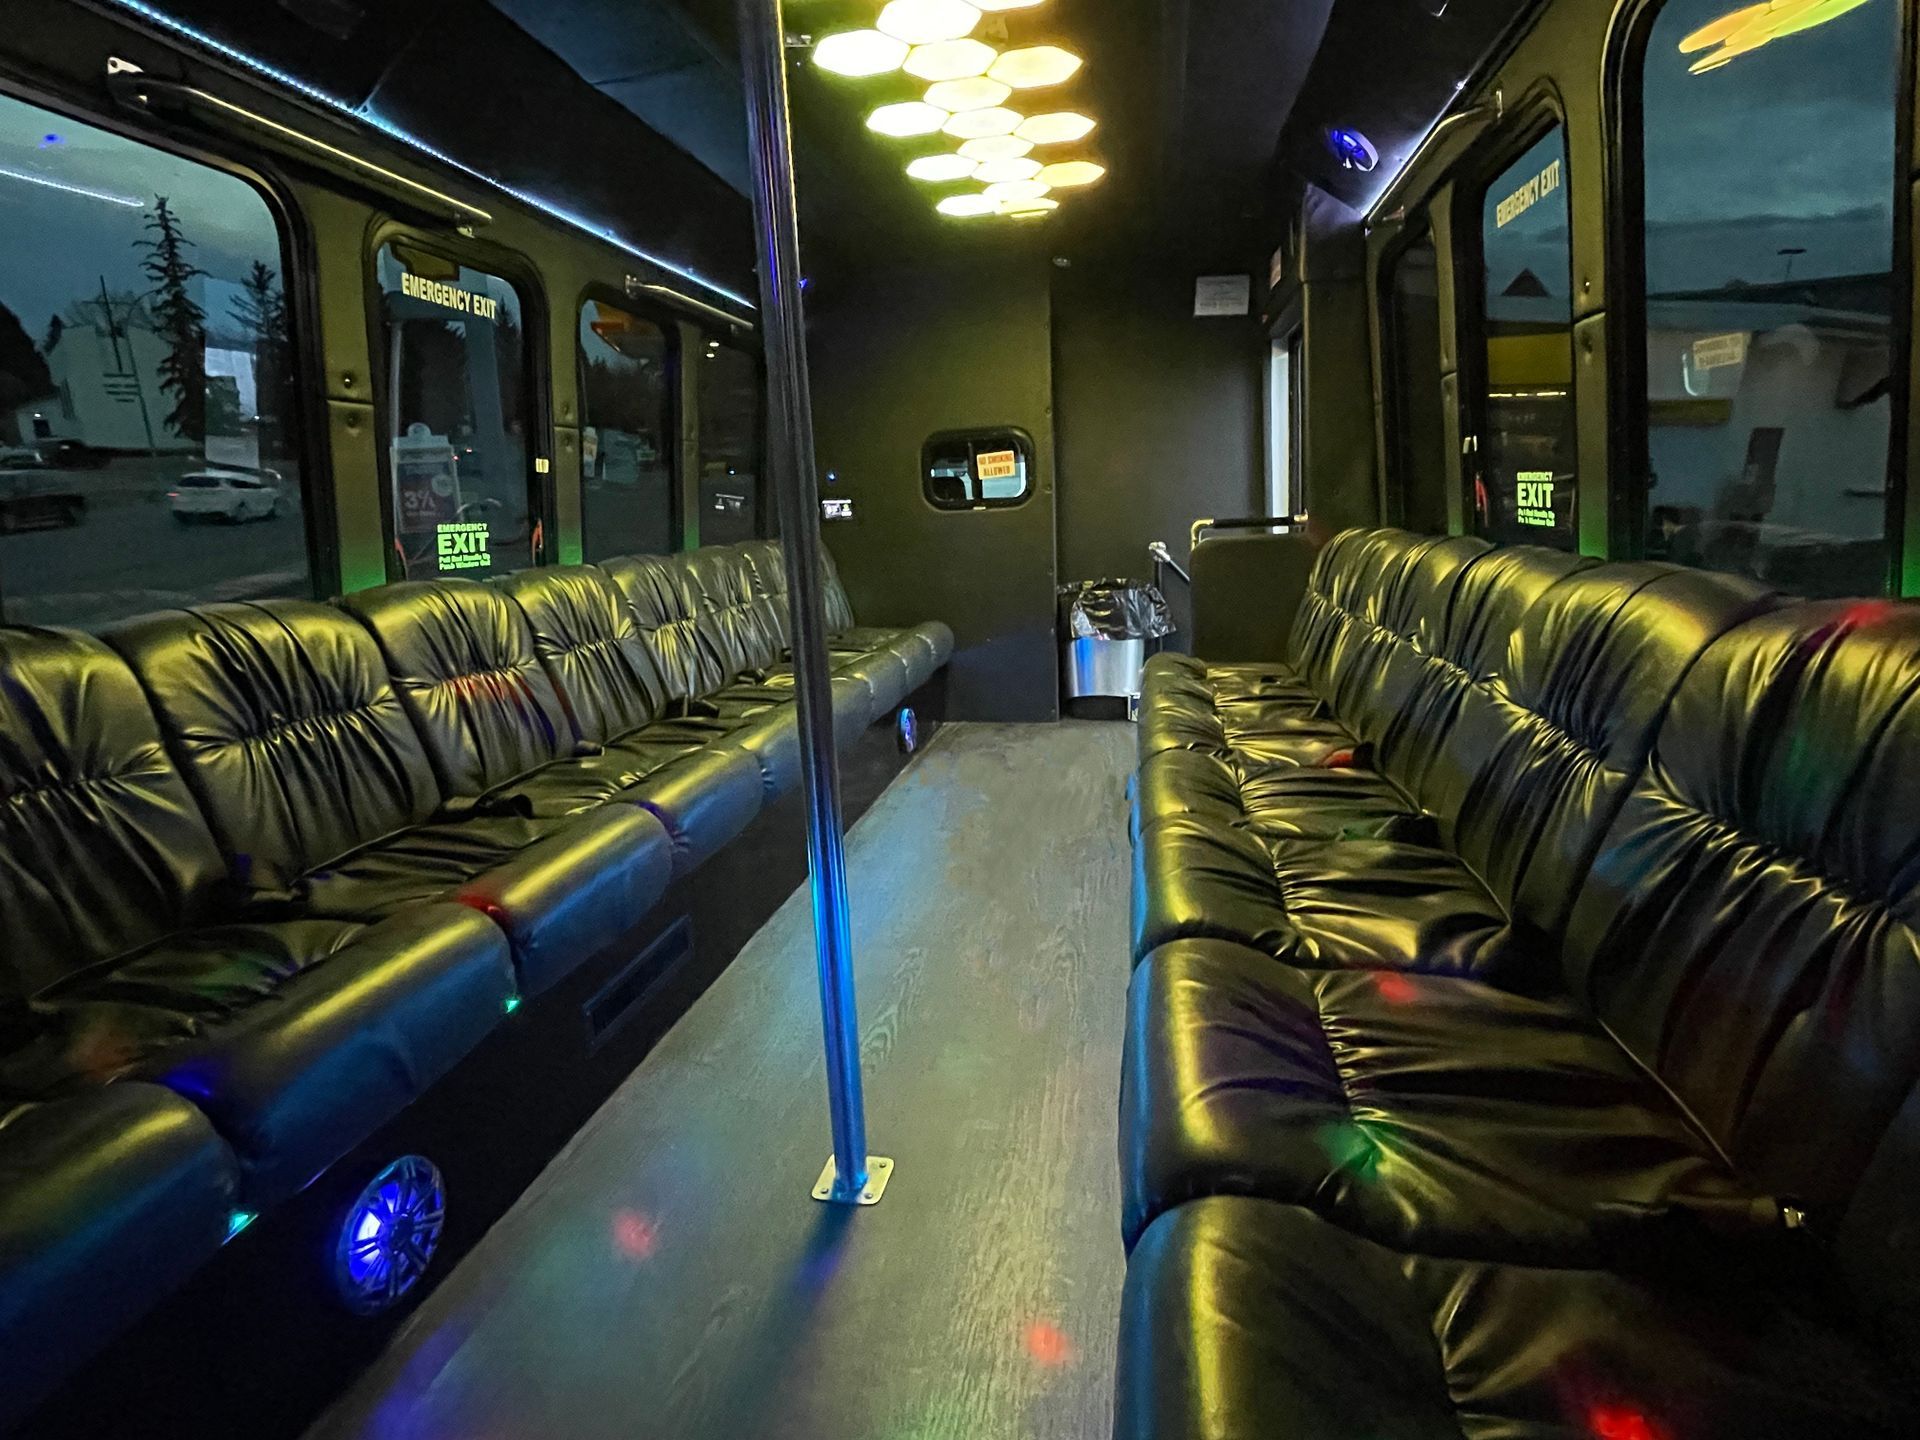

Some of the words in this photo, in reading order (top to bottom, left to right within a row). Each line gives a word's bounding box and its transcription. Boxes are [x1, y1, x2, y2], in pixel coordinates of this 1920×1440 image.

[1497, 174, 1539, 228] EMERGENCY
[1541, 158, 1560, 197] EXIT
[401, 272, 471, 313] EMERGENCY
[473, 294, 497, 320] EXIT
[983, 466, 1010, 476] ALLOWED
[1517, 482, 1554, 508] EXIT
[437, 523, 488, 533] EMERGENCY
[437, 531, 490, 555] EXIT
